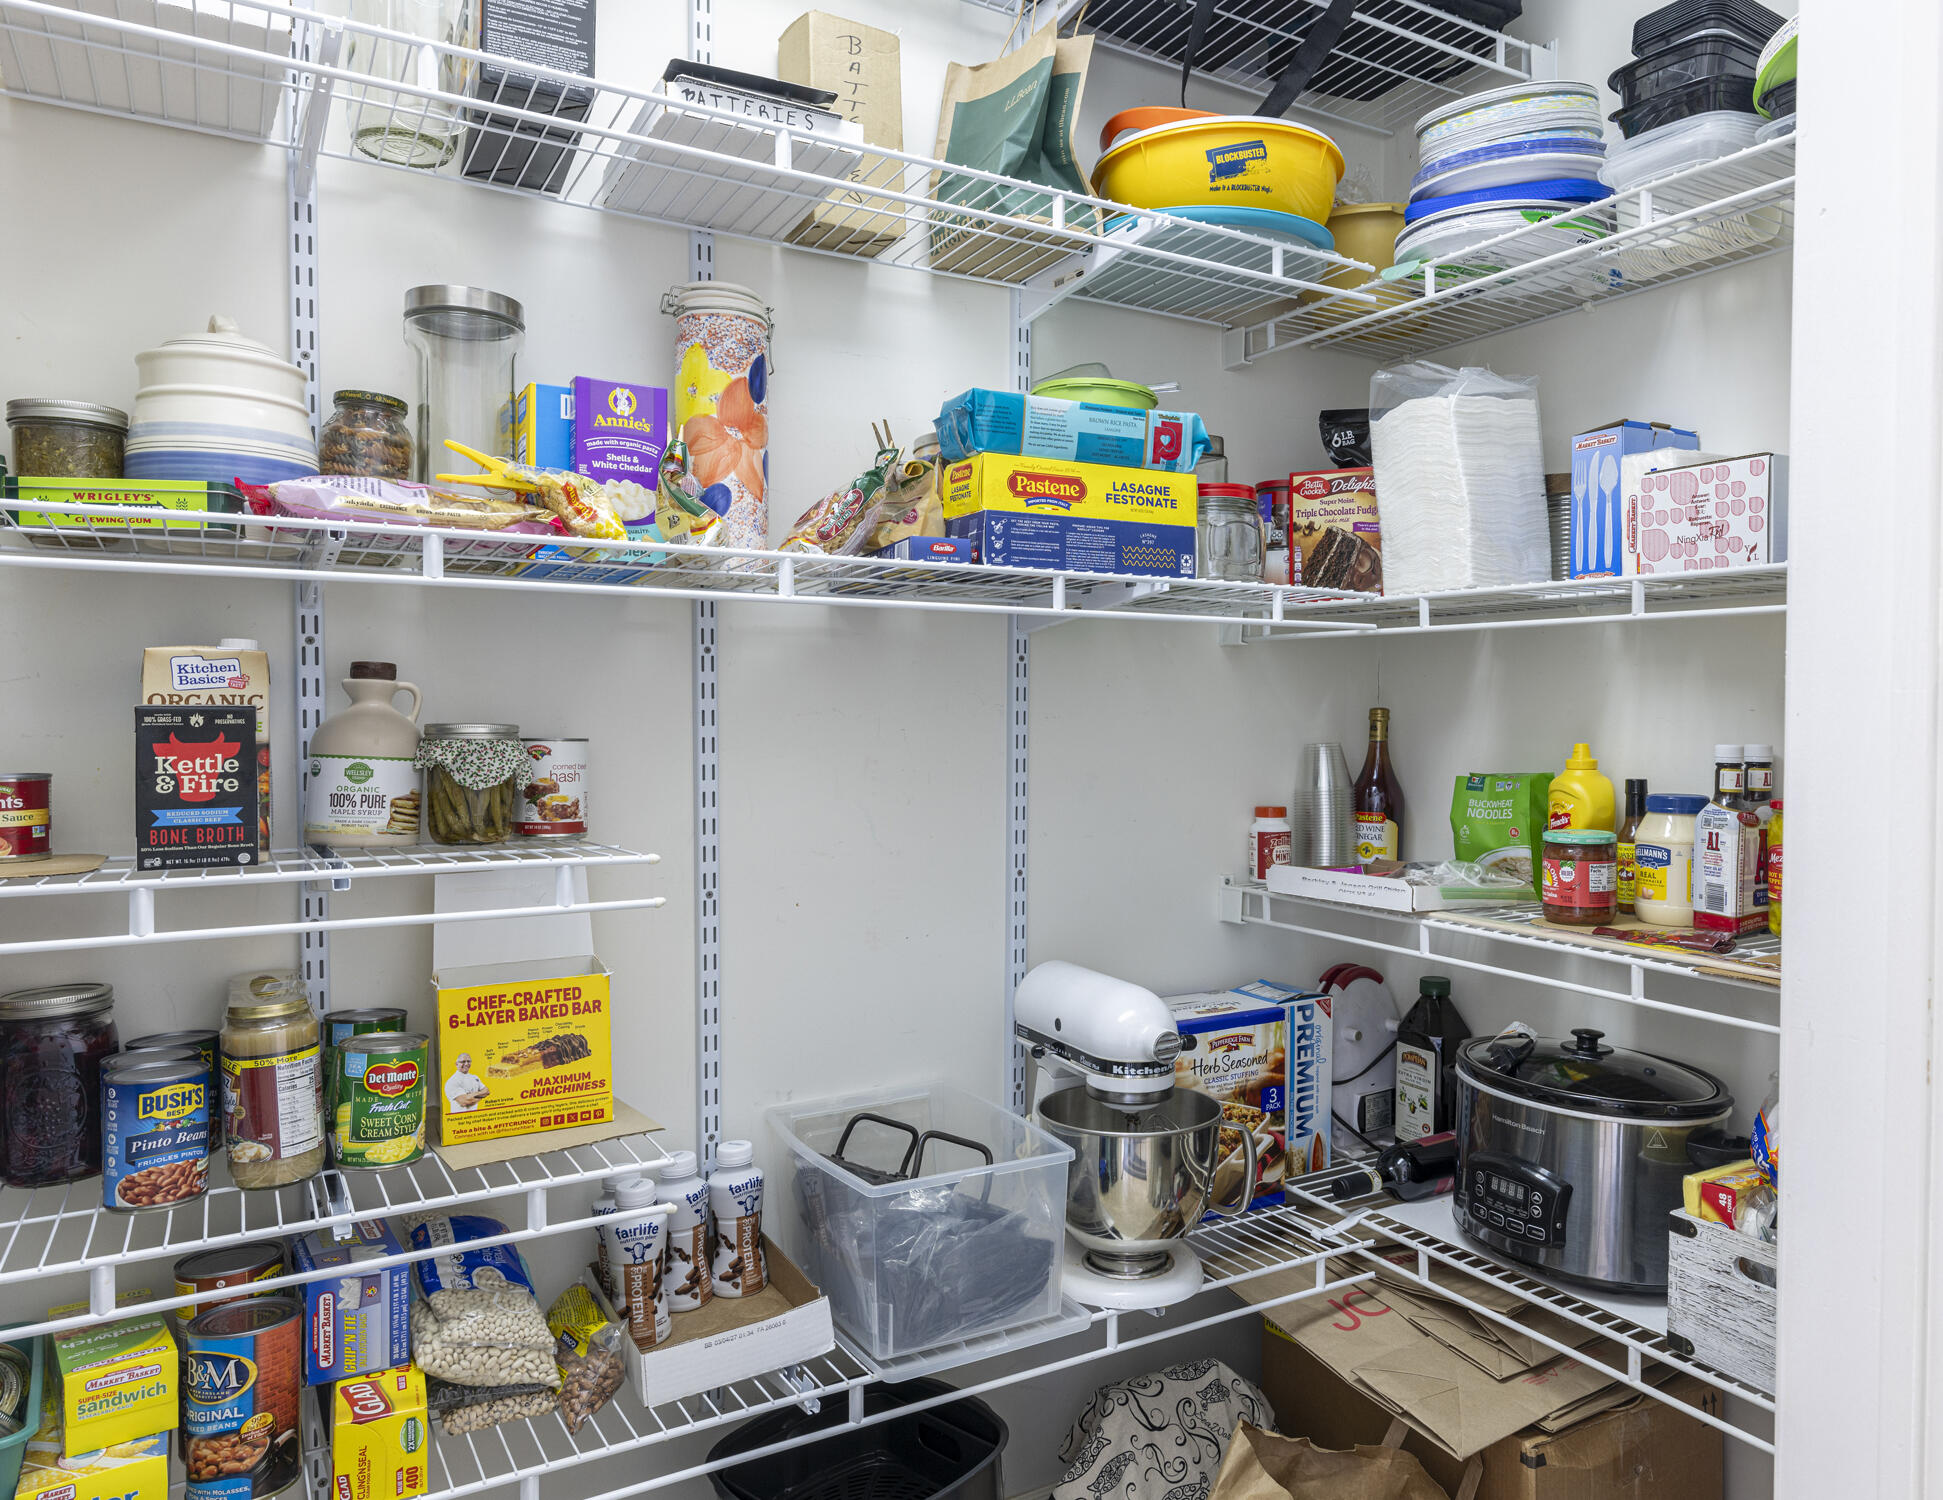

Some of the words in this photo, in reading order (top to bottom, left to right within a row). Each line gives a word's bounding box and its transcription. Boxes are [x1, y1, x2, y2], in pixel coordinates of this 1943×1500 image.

[681, 88, 814, 131] BATTERIES
[1216, 148, 1265, 164] BLOCKBUSTER
[594, 414, 652, 432] Annie's
[586, 439, 604, 447] made
[619, 440, 642, 449] organic
[642, 445, 659, 455] pasta
[1331, 432, 1342, 448] 6
[1342, 438, 1356, 446] BAG
[1577, 441, 1596, 450] MARKET
[606, 453, 631, 463] Shells
[592, 460, 618, 470] White
[619, 463, 653, 473] Cheddar
[1016, 475, 1080, 497] Pastene
[1112, 481, 1170, 496] LASAGNE
[1300, 487, 1328, 496] Crocker
[1303, 480, 1324, 492] Betty
[1331, 476, 1376, 493] Delights
[72, 492, 152, 502] WRIGLEY'S
[1105, 493, 1178, 509] FESTONATE
[1320, 498, 1337, 506] Super
[1296, 508, 1317, 519] Triple
[1318, 506, 1355, 517] Chocolate
[1357, 505, 1378, 516] Fudg
[1677, 533, 1709, 545] NingXia
[176, 662, 237, 674] Kitchen
[178, 674, 226, 685] Basics
[147, 693, 264, 709] ORGANIC
[155, 753, 240, 774] Kettle
[155, 775, 175, 793] &
[181, 774, 239, 793] Fire
[549, 770, 581, 783] hash
[336, 785, 380, 793] ORGANIC
[329, 793, 357, 808] 100%
[360, 794, 387, 809] PURE
[1468, 799, 1514, 807] BUCKWHEAT
[2, 813, 34, 822] Sauce
[1466, 807, 1513, 819] NOODLES
[150, 828, 188, 845] BONE
[196, 826, 245, 843] BROTH
[1356, 833, 1383, 841] INEGAR
[1365, 825, 1385, 833] WINE
[1636, 848, 1668, 860] ELLMANN'S
[1640, 871, 1657, 879] REAL
[466, 986, 582, 1012] CHEF-CRAFTED
[448, 1008, 516, 1029] 6-LAYER
[518, 1002, 569, 1023] BAKED
[571, 999, 602, 1016] BAR
[1211, 1036, 1238, 1049] PEPPERIDGE
[1238, 1036, 1252, 1044] FARM
[1311, 1025, 1327, 1064] original
[1190, 1057, 1221, 1077] Herb
[1221, 1049, 1268, 1073] Seasoned
[1295, 1003, 1314, 1138] PREMIUM
[368, 1073, 386, 1084] Del
[387, 1070, 417, 1082] Monte
[533, 1071, 592, 1088] MAXIMUM
[1203, 1075, 1229, 1085] CLASSIC
[1230, 1069, 1259, 1081] STUFFING
[1398, 1070, 1413, 1079] EXTRA
[1413, 1075, 1431, 1084] VIRGIN
[382, 1084, 403, 1092] Quality
[520, 1078, 606, 1100] CRUNCHINESS
[1269, 1088, 1278, 1103] 3
[142, 1087, 203, 1116] BUSH'S
[369, 1101, 395, 1114] Fresh
[394, 1100, 412, 1111] Cut
[1266, 1101, 1281, 1111] PACK
[166, 1108, 186, 1117] BEST
[360, 1116, 392, 1128] SWEET
[393, 1112, 417, 1126] CORN
[360, 1127, 392, 1138] CREAM
[394, 1122, 417, 1135] STYLE
[493, 1118, 537, 1129] #FITCRUNCH
[1492, 1114, 1521, 1128] Hamilton
[1521, 1123, 1545, 1135] Beach
[131, 1137, 172, 1154] Pinto
[176, 1130, 208, 1145] Beans
[137, 1154, 179, 1168] FRIJOLES
[181, 1149, 204, 1158] PINTOS
[728, 1175, 764, 1196] fairlife
[1718, 1193, 1727, 1206] 48
[615, 1222, 659, 1240] fairlife
[619, 1236, 644, 1244] nutrition
[697, 1230, 708, 1280] PROTEIN
[742, 1228, 754, 1272] PROTEIN
[631, 1275, 644, 1324] PROTEIN
[321, 1296, 331, 1330] BASKET
[359, 1313, 367, 1326] BAGS
[344, 1313, 357, 1330] TIE
[344, 1331, 357, 1346] 'N
[359, 1327, 367, 1350] KITCHEN
[321, 1331, 332, 1365] MARKET
[344, 1347, 357, 1373] GRIP
[359, 1350, 367, 1367] TALL
[87, 1376, 125, 1390] MARKET
[127, 1366, 160, 1380] BASKET
[187, 1357, 243, 1390] B&M
[77, 1381, 167, 1415] sandwich
[78, 1390, 117, 1404] SUPER-SIZE
[349, 1384, 386, 1415] GLAD
[78, 1408, 115, 1420] RESEALABLE
[207, 1421, 237, 1431] BEANS
[408, 1440, 415, 1451] 2X
[357, 1445, 367, 1466] SEAL
[406, 1466, 419, 1489] 400
[43, 1487, 71, 1499] MARKET
[212, 1486, 250, 1496] MOLASSES,
[339, 1476, 351, 1500] GLAD
